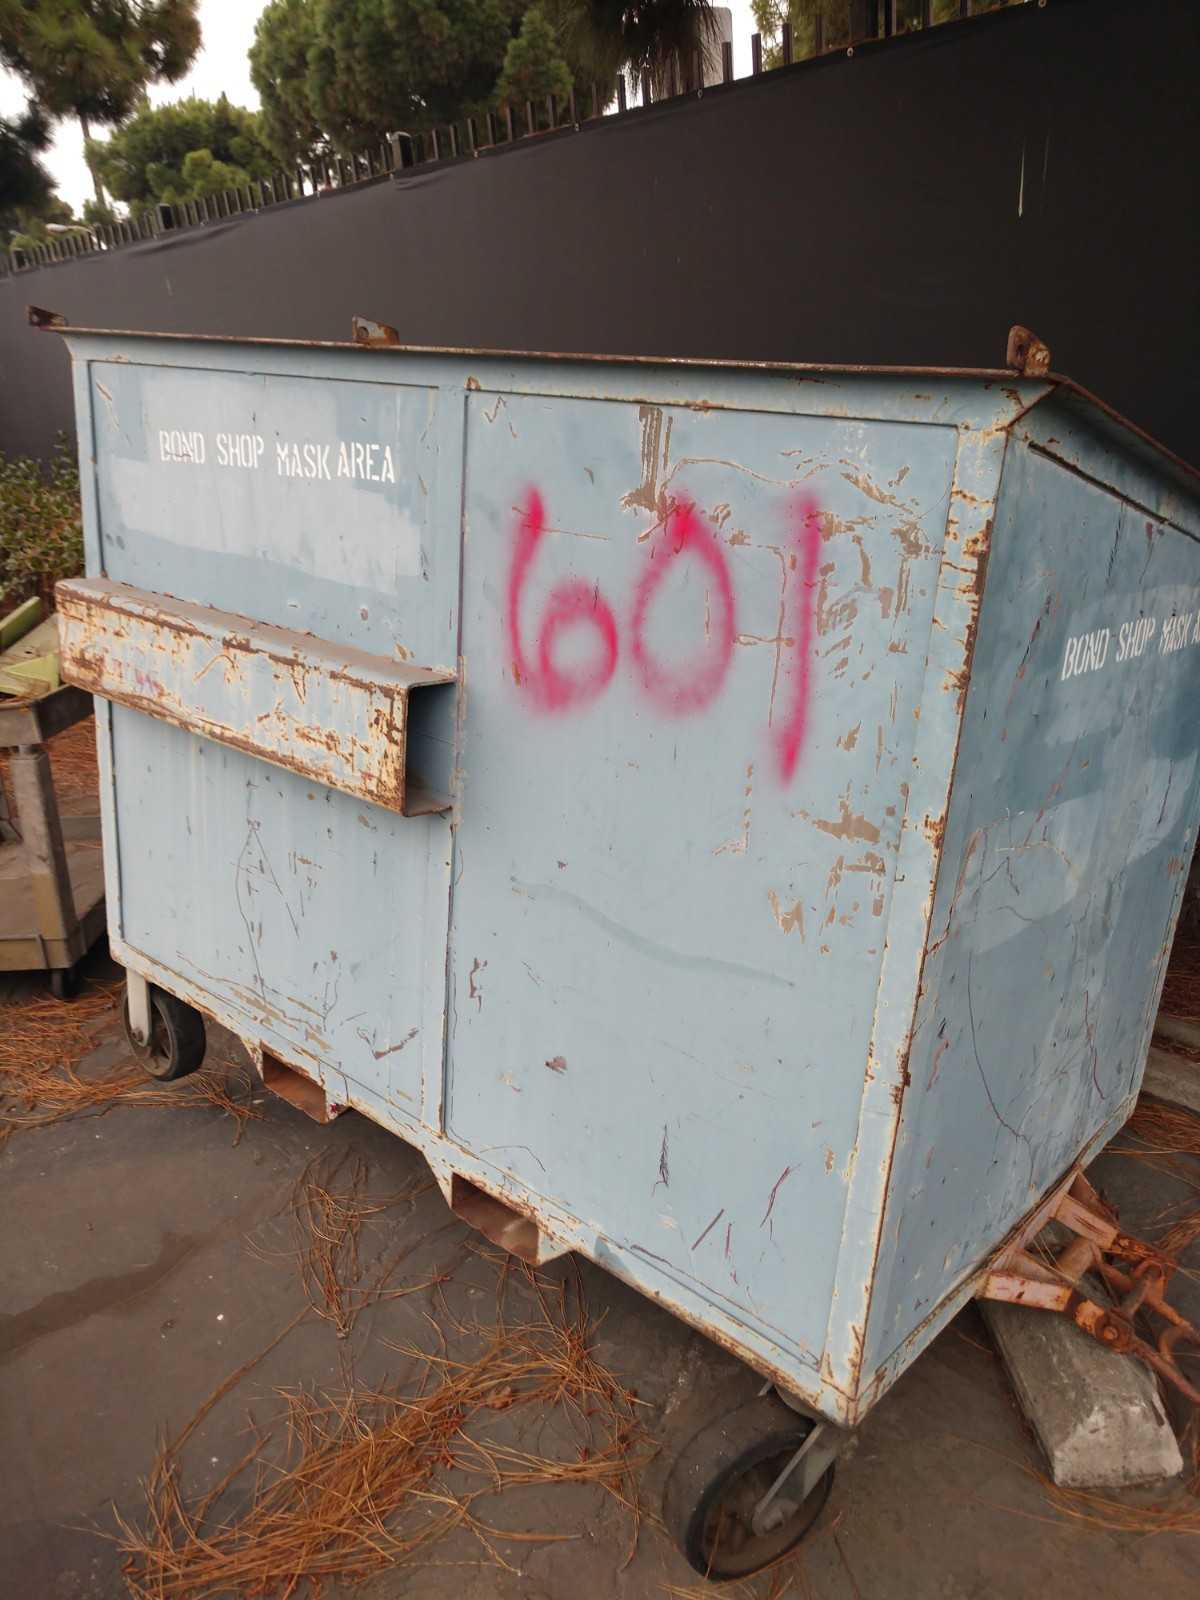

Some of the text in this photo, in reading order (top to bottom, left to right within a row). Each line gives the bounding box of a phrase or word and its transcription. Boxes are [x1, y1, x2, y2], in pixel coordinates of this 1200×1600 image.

[159, 430, 395, 484] BOND SHOP MASK AREA
[507, 482, 824, 790] 601
[1061, 628, 1110, 680] BOND
[1116, 617, 1156, 662] SHOP
[1159, 613, 1192, 655] MASK
